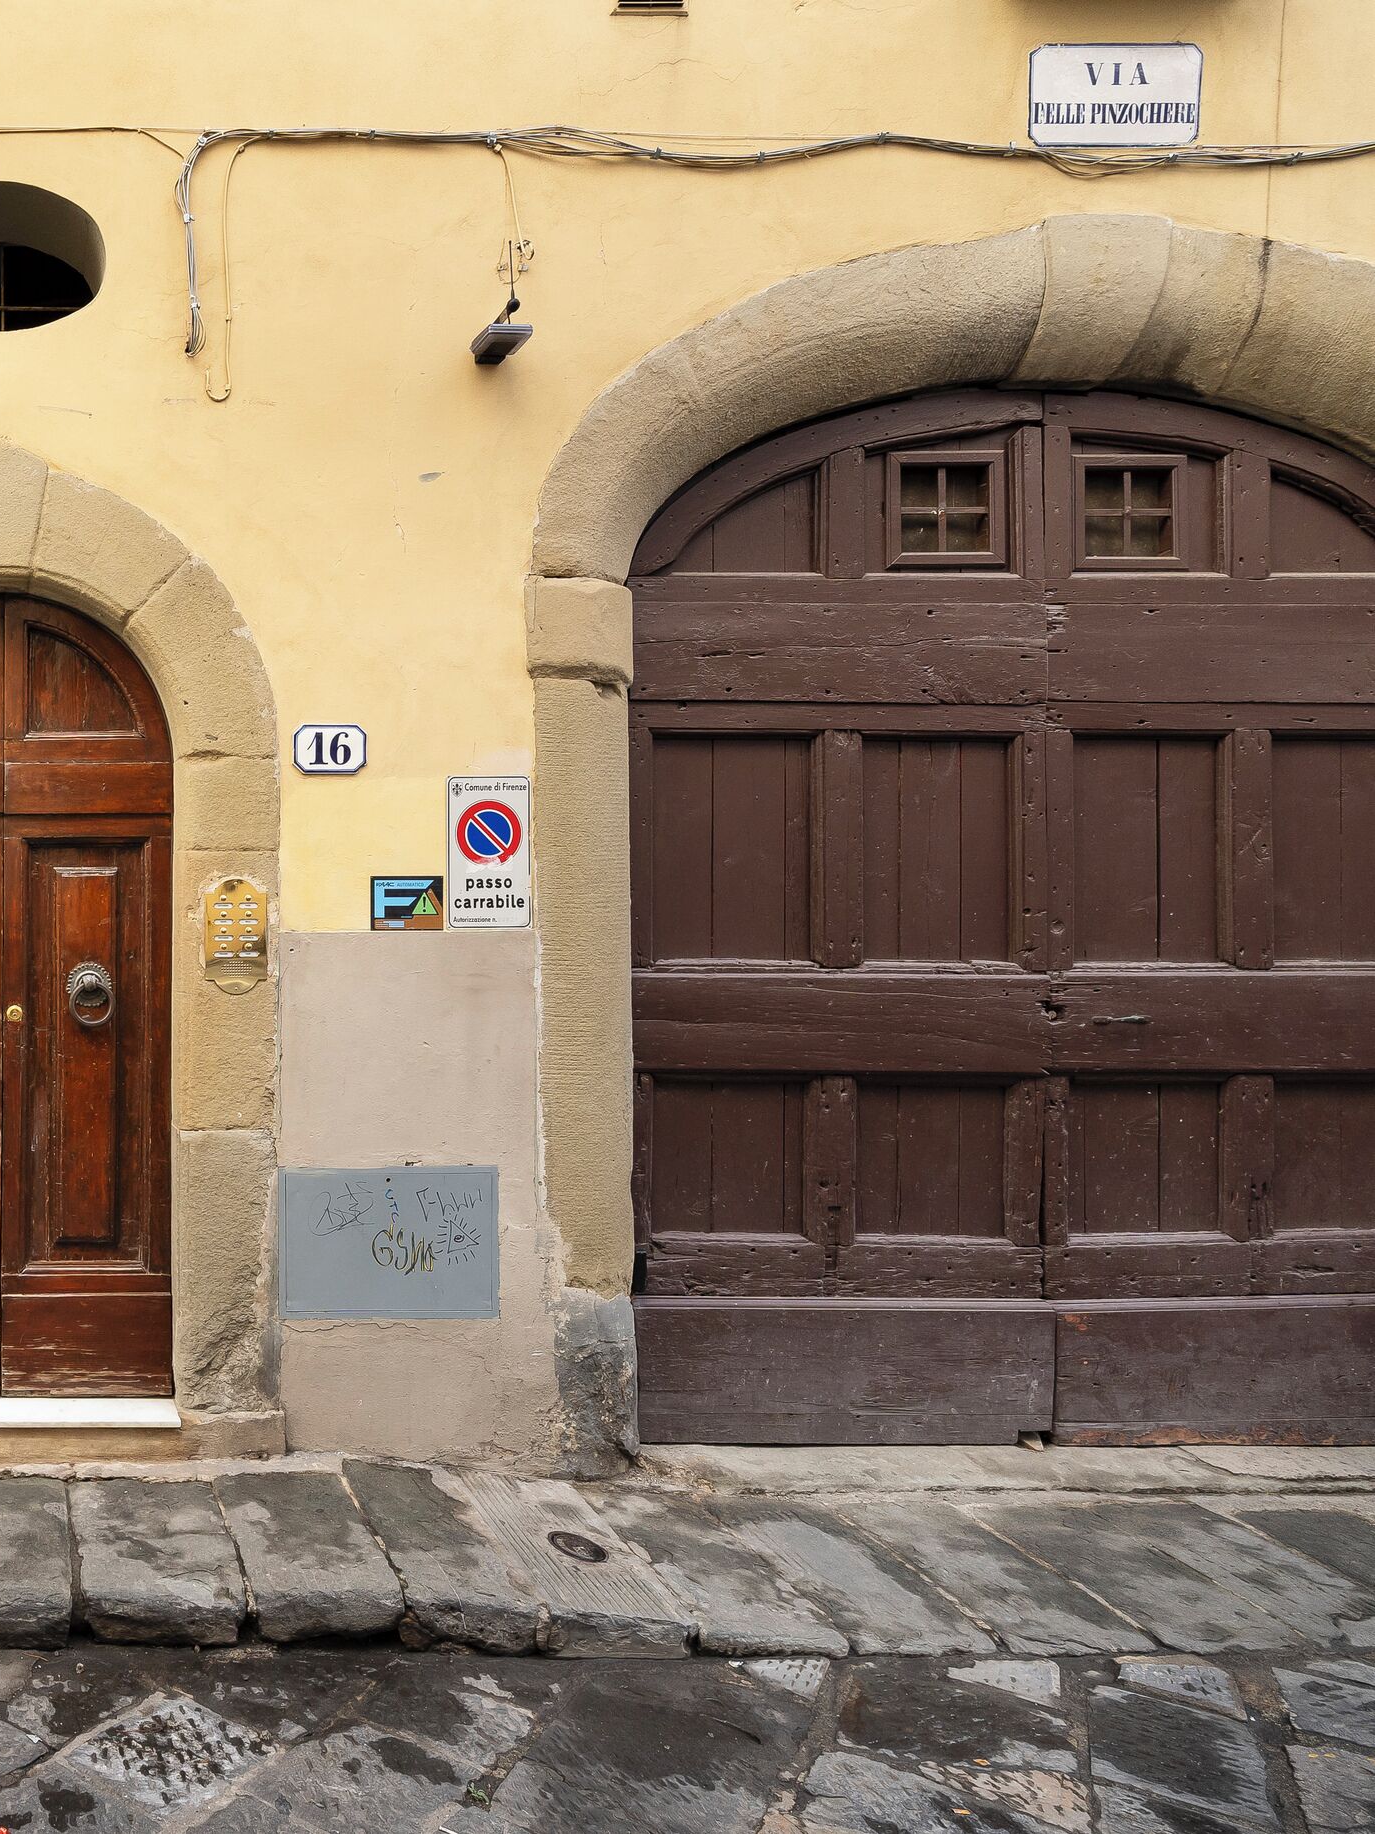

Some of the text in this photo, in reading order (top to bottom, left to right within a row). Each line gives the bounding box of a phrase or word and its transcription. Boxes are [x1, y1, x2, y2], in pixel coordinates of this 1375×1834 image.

[1084, 62, 1150, 86] VIA
[1033, 102, 1196, 125] DELLE PINZOCHERE
[307, 731, 351, 765] 16
[464, 781, 527, 791] Comune di Firenze
[465, 878, 513, 891] passo
[454, 894, 525, 909] carrabile
[453, 915, 491, 923] Autorizzazione
